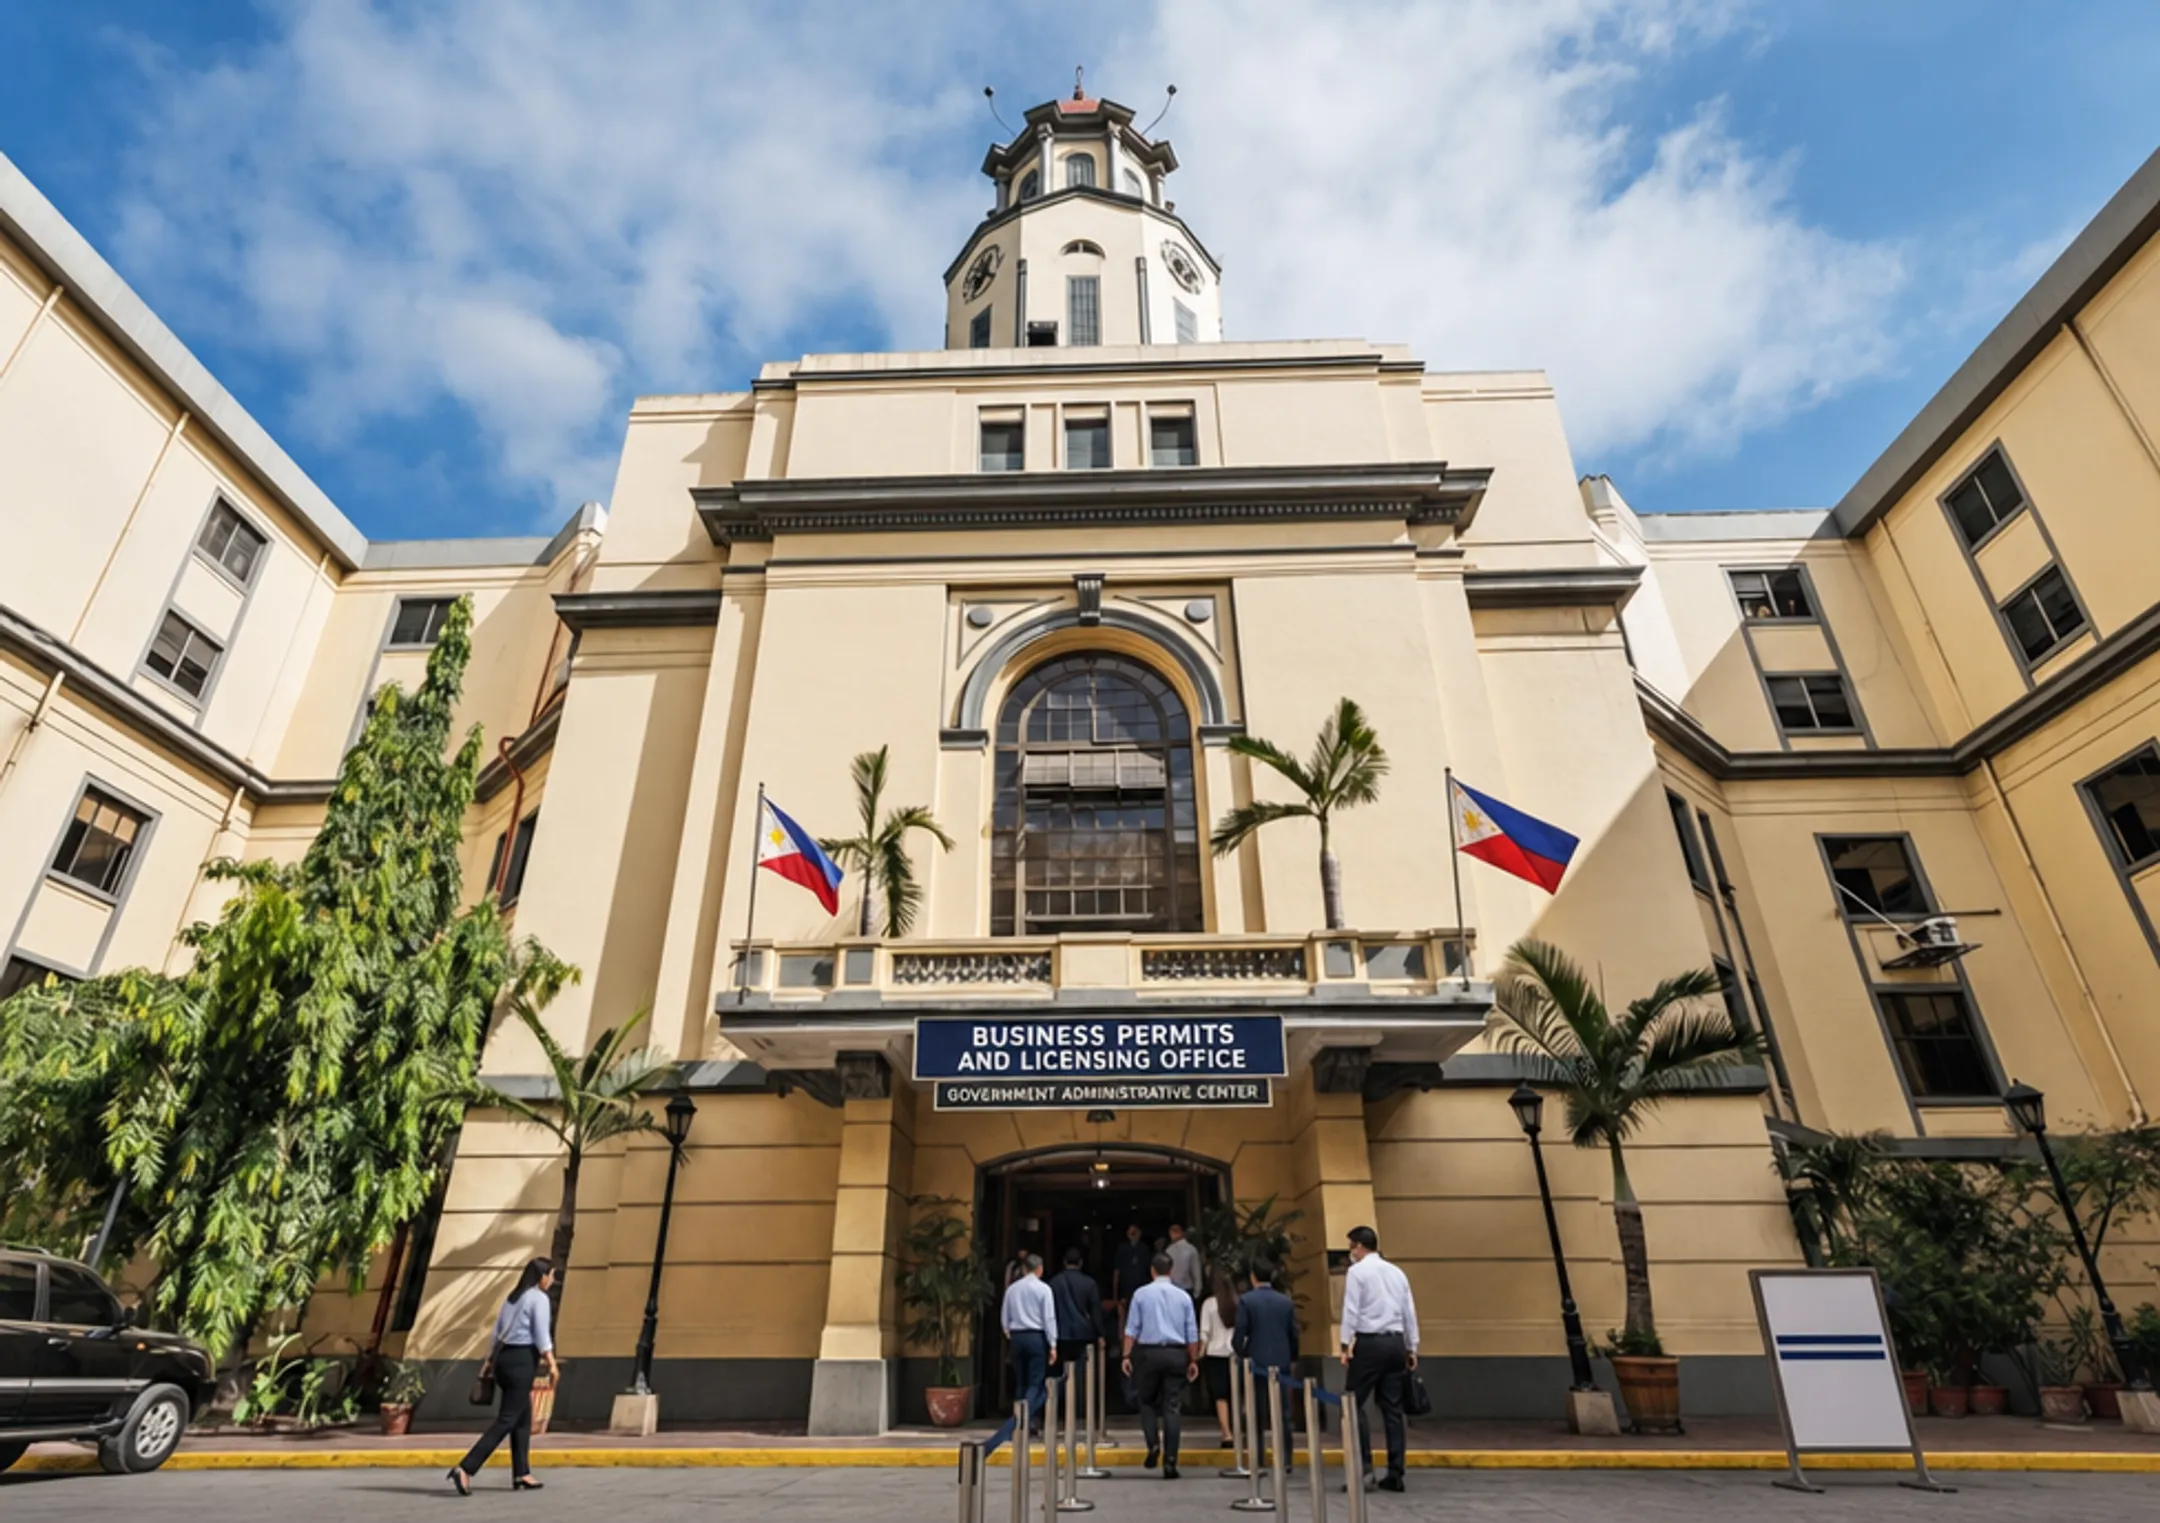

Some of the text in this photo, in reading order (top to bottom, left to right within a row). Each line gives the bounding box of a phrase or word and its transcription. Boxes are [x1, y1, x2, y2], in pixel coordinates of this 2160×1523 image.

[972, 1023, 1234, 1047] BUSINESS PERMITS
[957, 1048, 1247, 1071] AND LICENSING OFFICE
[947, 1084, 1258, 1102] GOVERNMENT ADMINISTRATIVE CENTER
